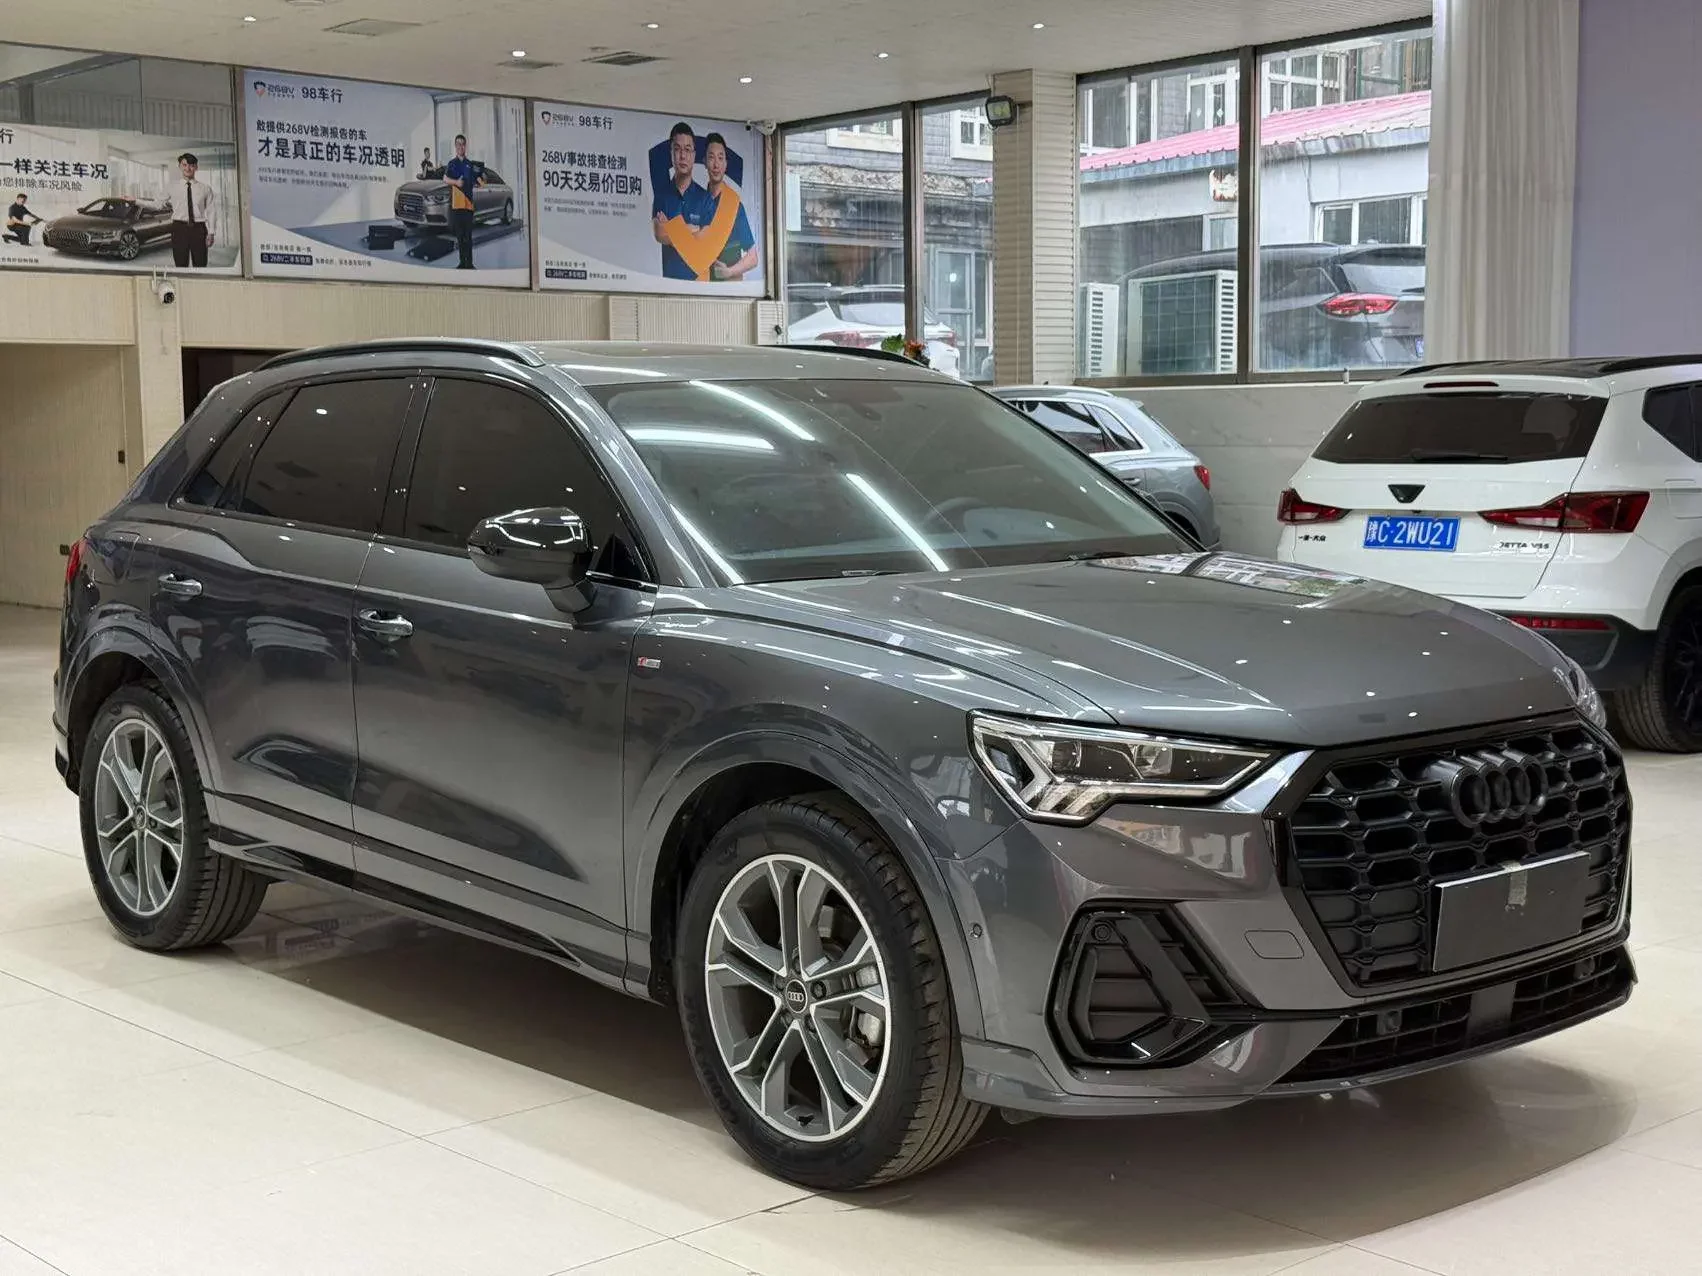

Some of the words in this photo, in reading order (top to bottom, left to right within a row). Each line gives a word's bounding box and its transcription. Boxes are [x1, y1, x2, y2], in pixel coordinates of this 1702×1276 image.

[301, 86, 343, 104] 98车行
[579, 114, 613, 130] 98车行
[257, 136, 405, 168] 才是真正的车况透明
[542, 150, 628, 171] 268V事故排查检测
[542, 170, 642, 196] 90天交易价回购
[1500, 541, 1527, 549] JETTA
